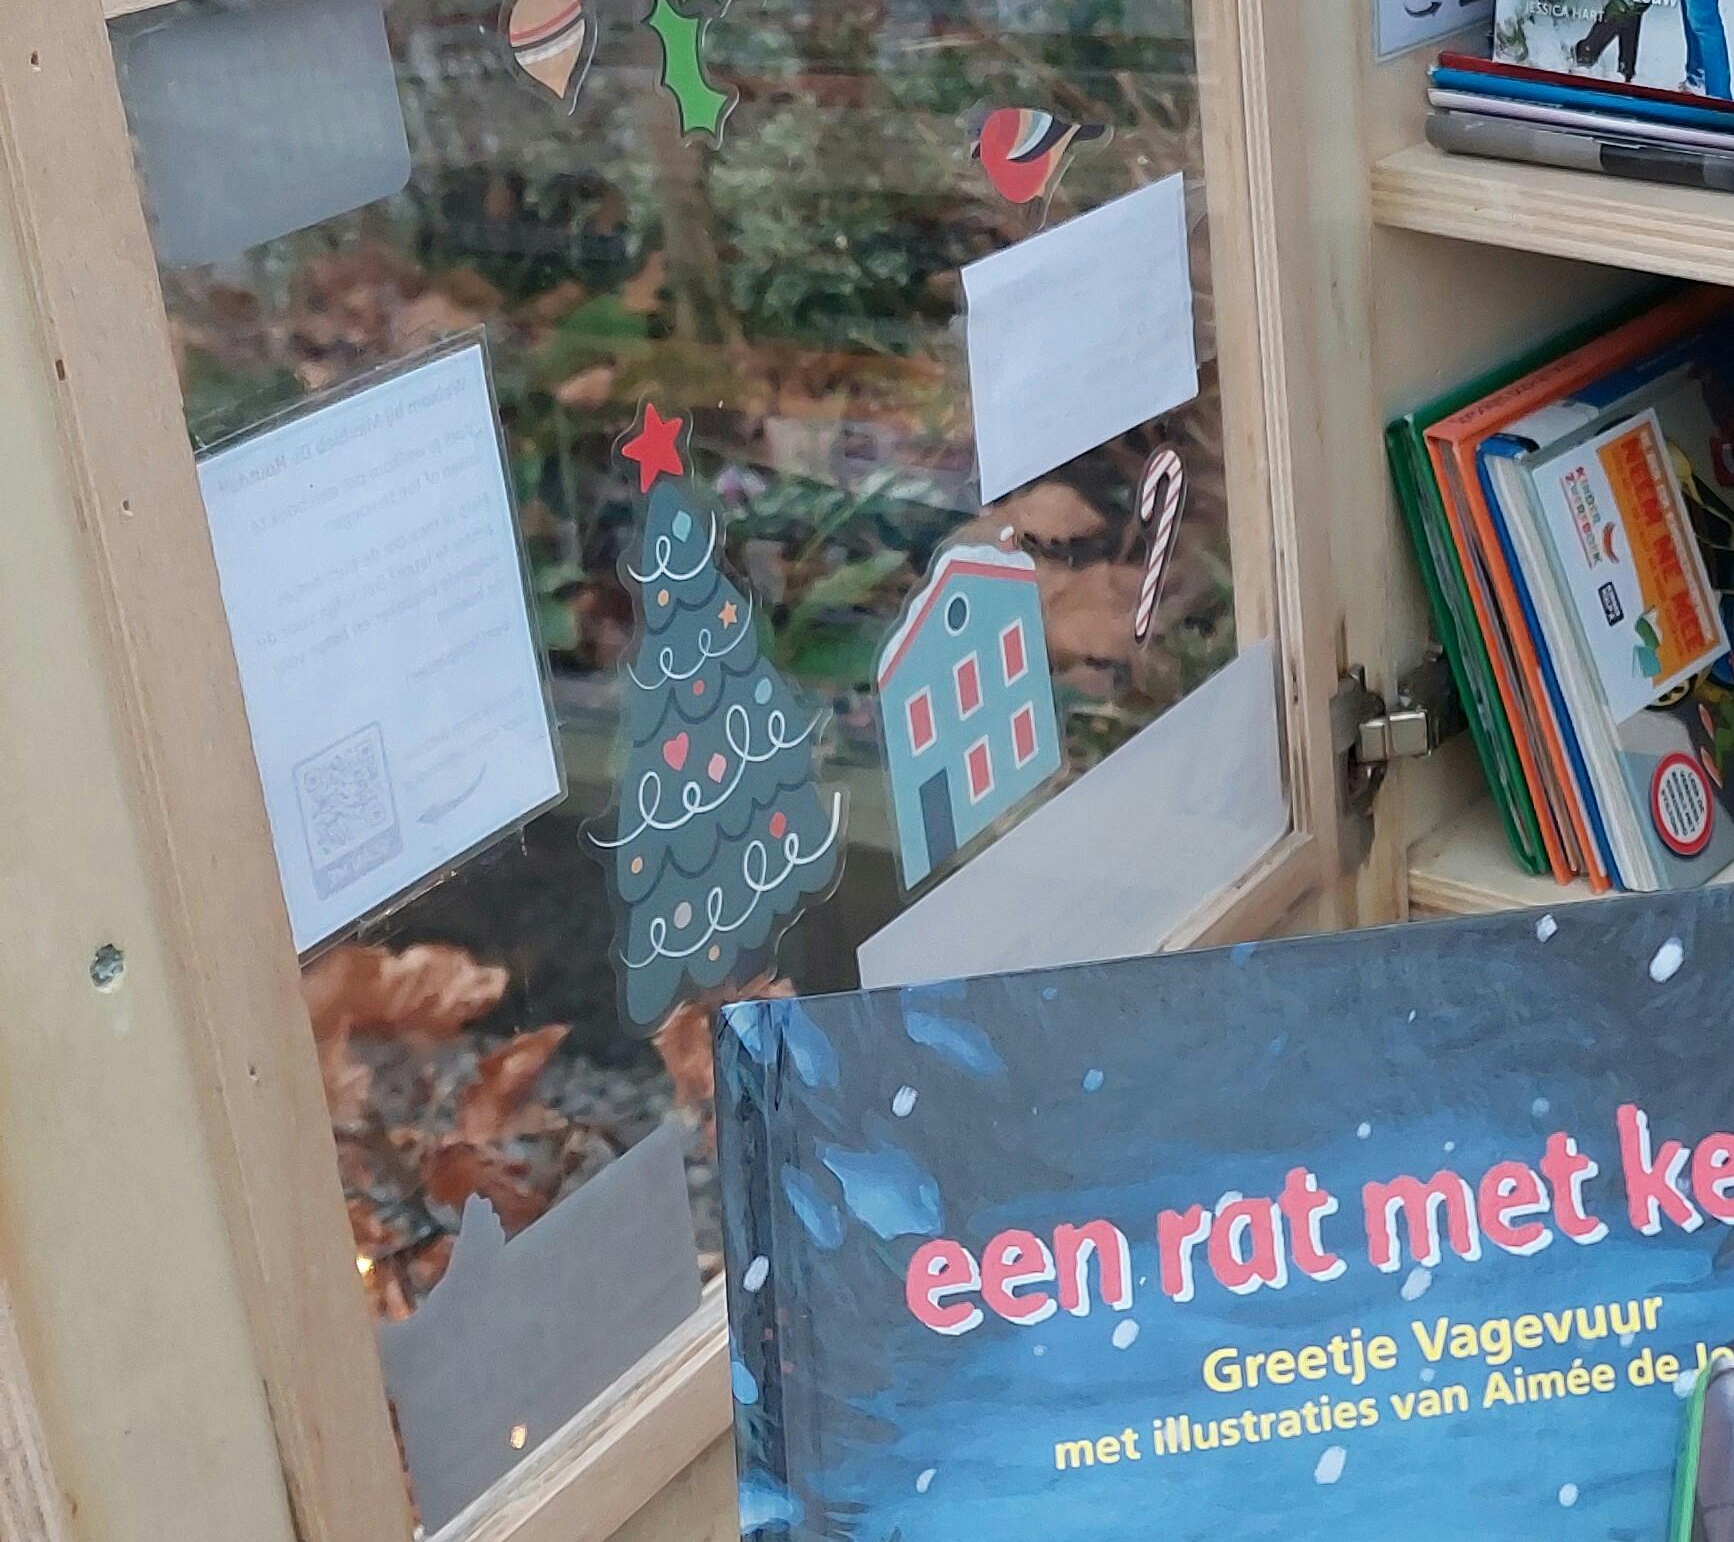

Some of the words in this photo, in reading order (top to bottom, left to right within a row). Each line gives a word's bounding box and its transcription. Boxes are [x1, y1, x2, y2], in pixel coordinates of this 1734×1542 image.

[906, 1211, 1134, 1336] een
[1155, 1165, 1349, 1308] rat
[1362, 1129, 1609, 1274] met
[1200, 1339, 1403, 1397] Greetje
[1410, 1291, 1665, 1363] Vagevuur
[1053, 1425, 1143, 1475] met
[1151, 1393, 1382, 1461] illustraties
[1389, 1379, 1471, 1425] van
[1481, 1353, 1618, 1411] Aimée
[1628, 1348, 1679, 1386] de
